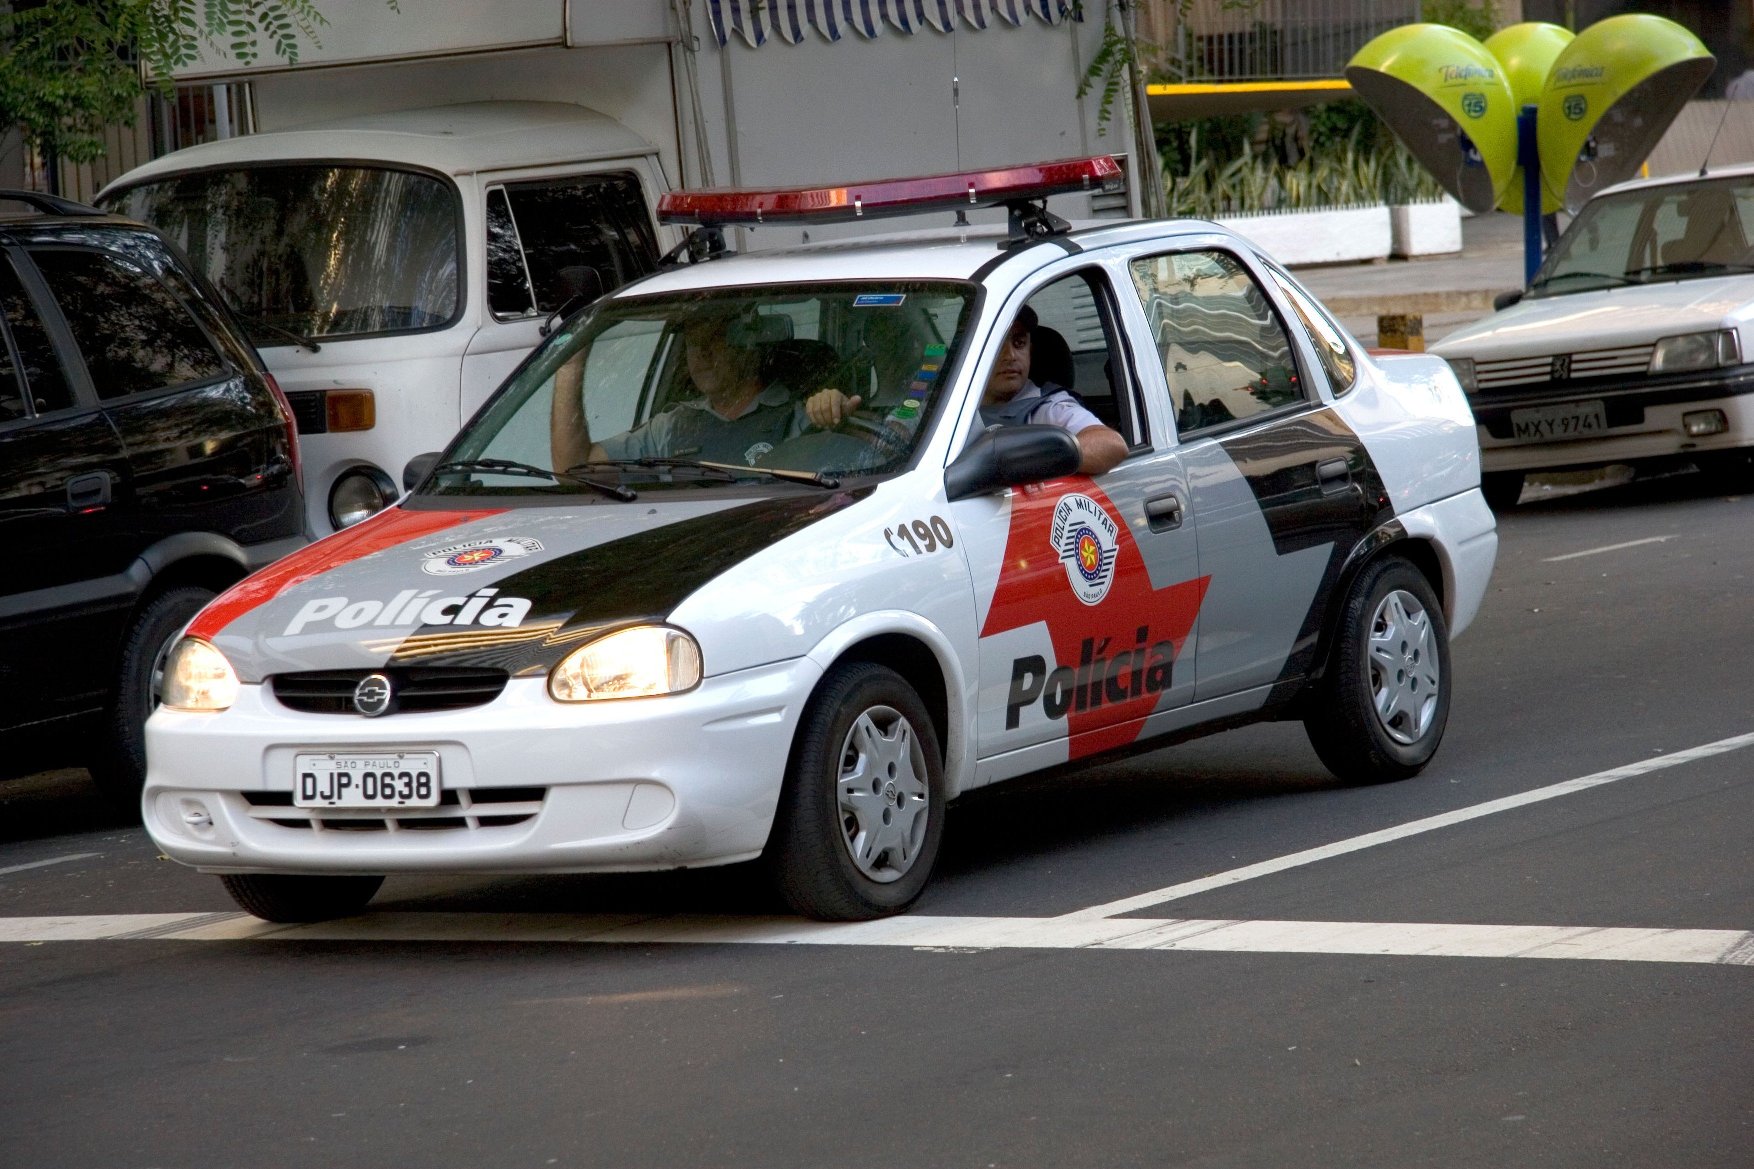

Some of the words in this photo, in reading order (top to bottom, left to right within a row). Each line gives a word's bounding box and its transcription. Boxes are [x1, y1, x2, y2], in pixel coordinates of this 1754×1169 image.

[1466, 99, 1484, 114] 15
[1566, 103, 1583, 117] 15
[897, 515, 954, 555] 190
[1075, 497, 1114, 537] MILITAR
[283, 588, 532, 636] Polícia
[1005, 625, 1175, 731] Polícia
[364, 760, 400, 769] PAULO
